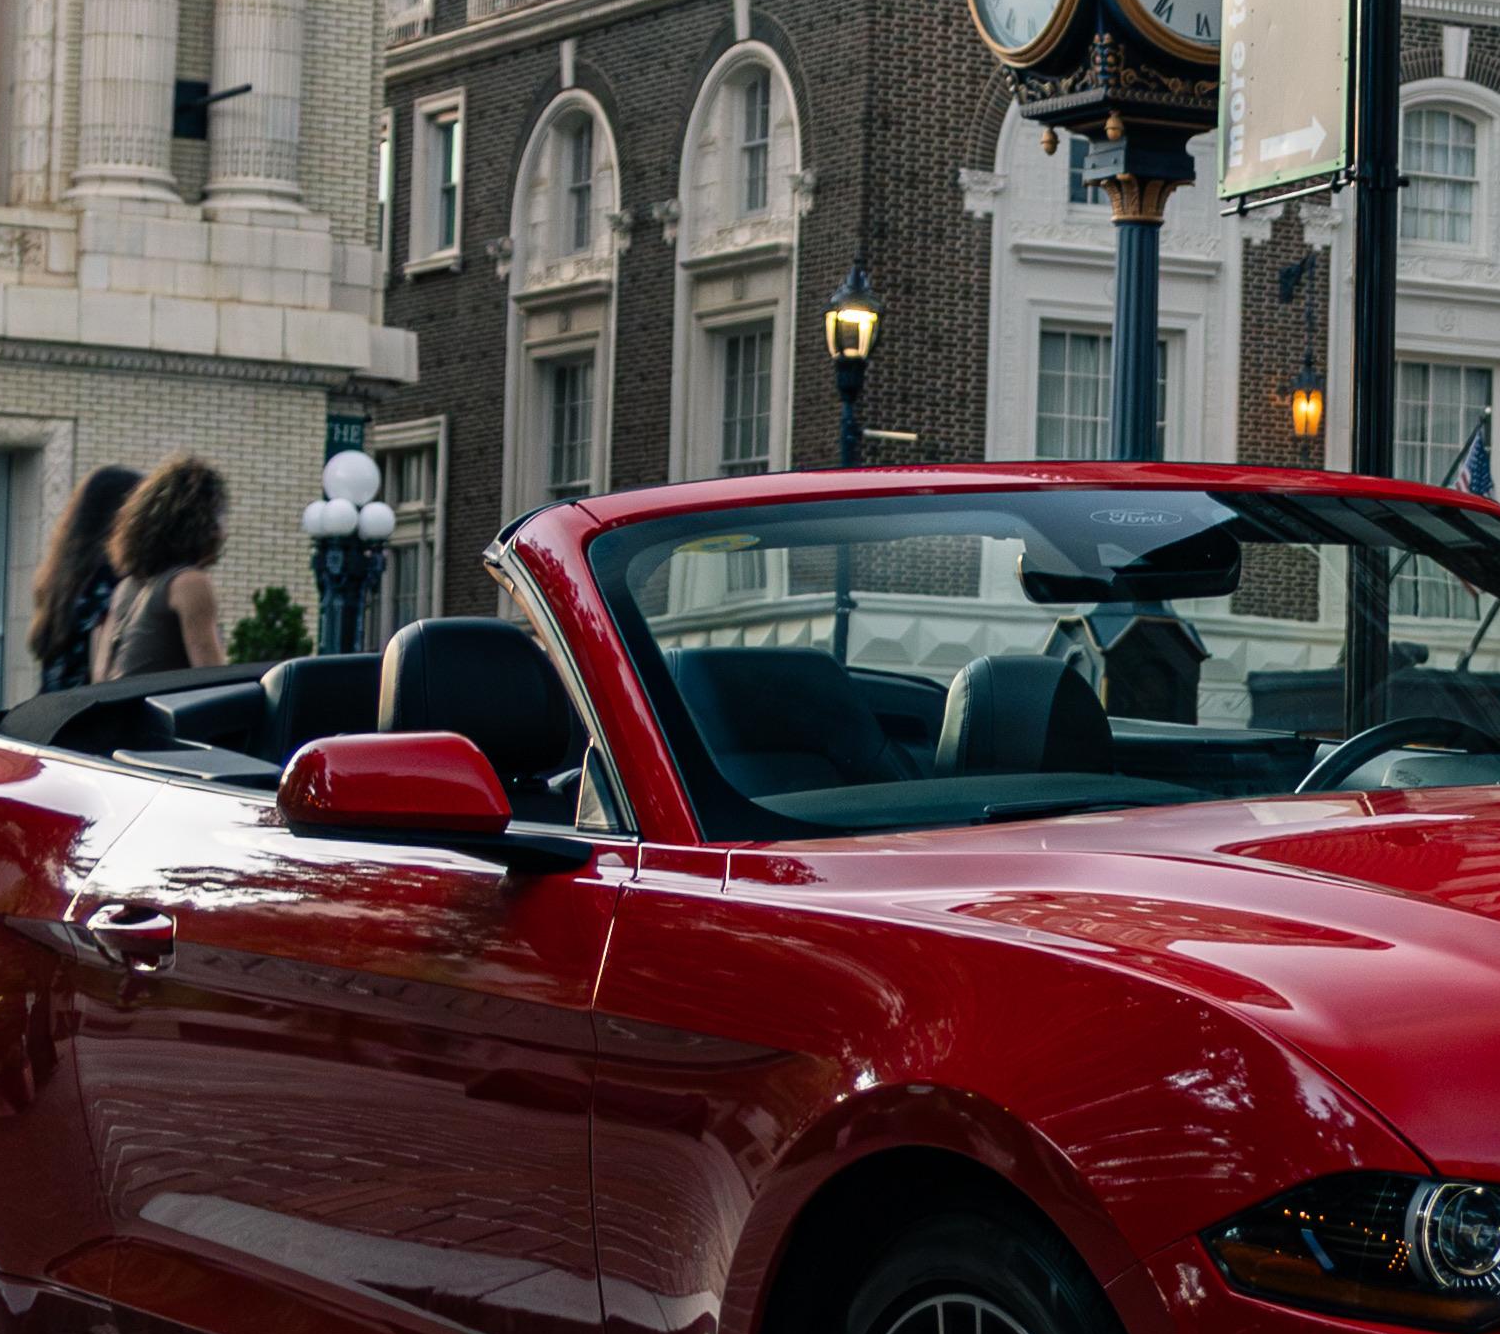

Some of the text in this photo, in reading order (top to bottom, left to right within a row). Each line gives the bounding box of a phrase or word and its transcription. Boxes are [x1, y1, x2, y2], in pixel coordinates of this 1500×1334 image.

[1229, 40, 1246, 167] more
[328, 423, 361, 443] HE
[1108, 511, 1164, 524] Ford
